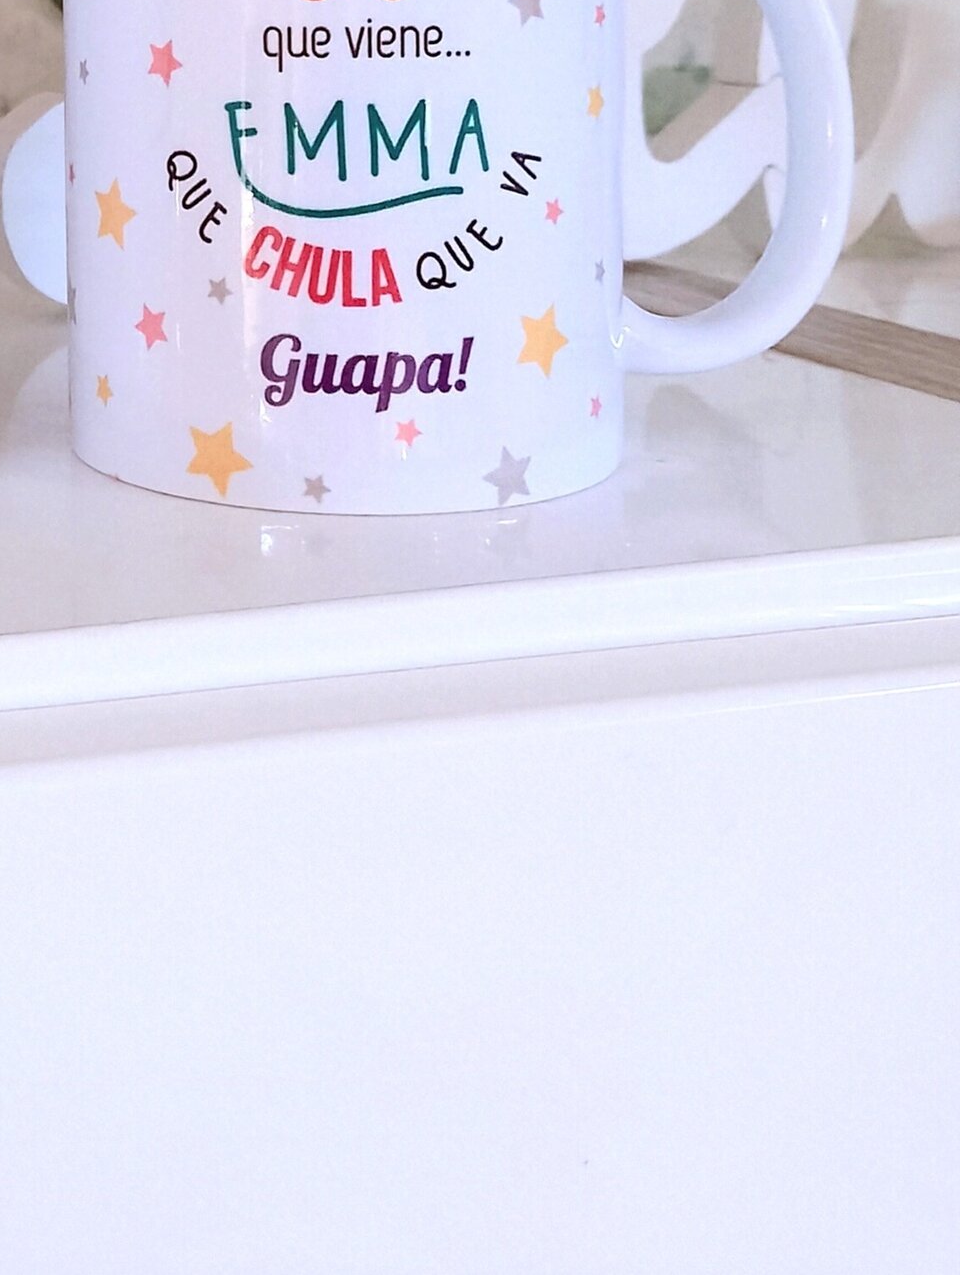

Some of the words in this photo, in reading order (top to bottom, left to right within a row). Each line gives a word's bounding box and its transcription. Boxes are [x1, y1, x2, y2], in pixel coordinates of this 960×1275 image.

[262, 25, 332, 73] que
[345, 18, 472, 59] viene...
[225, 99, 489, 219] EMMA
[167, 150, 228, 244] QUE
[242, 225, 403, 308] CHULA
[416, 219, 503, 291] QUE
[500, 151, 542, 197] VA
[260, 333, 475, 413] Guapa!
